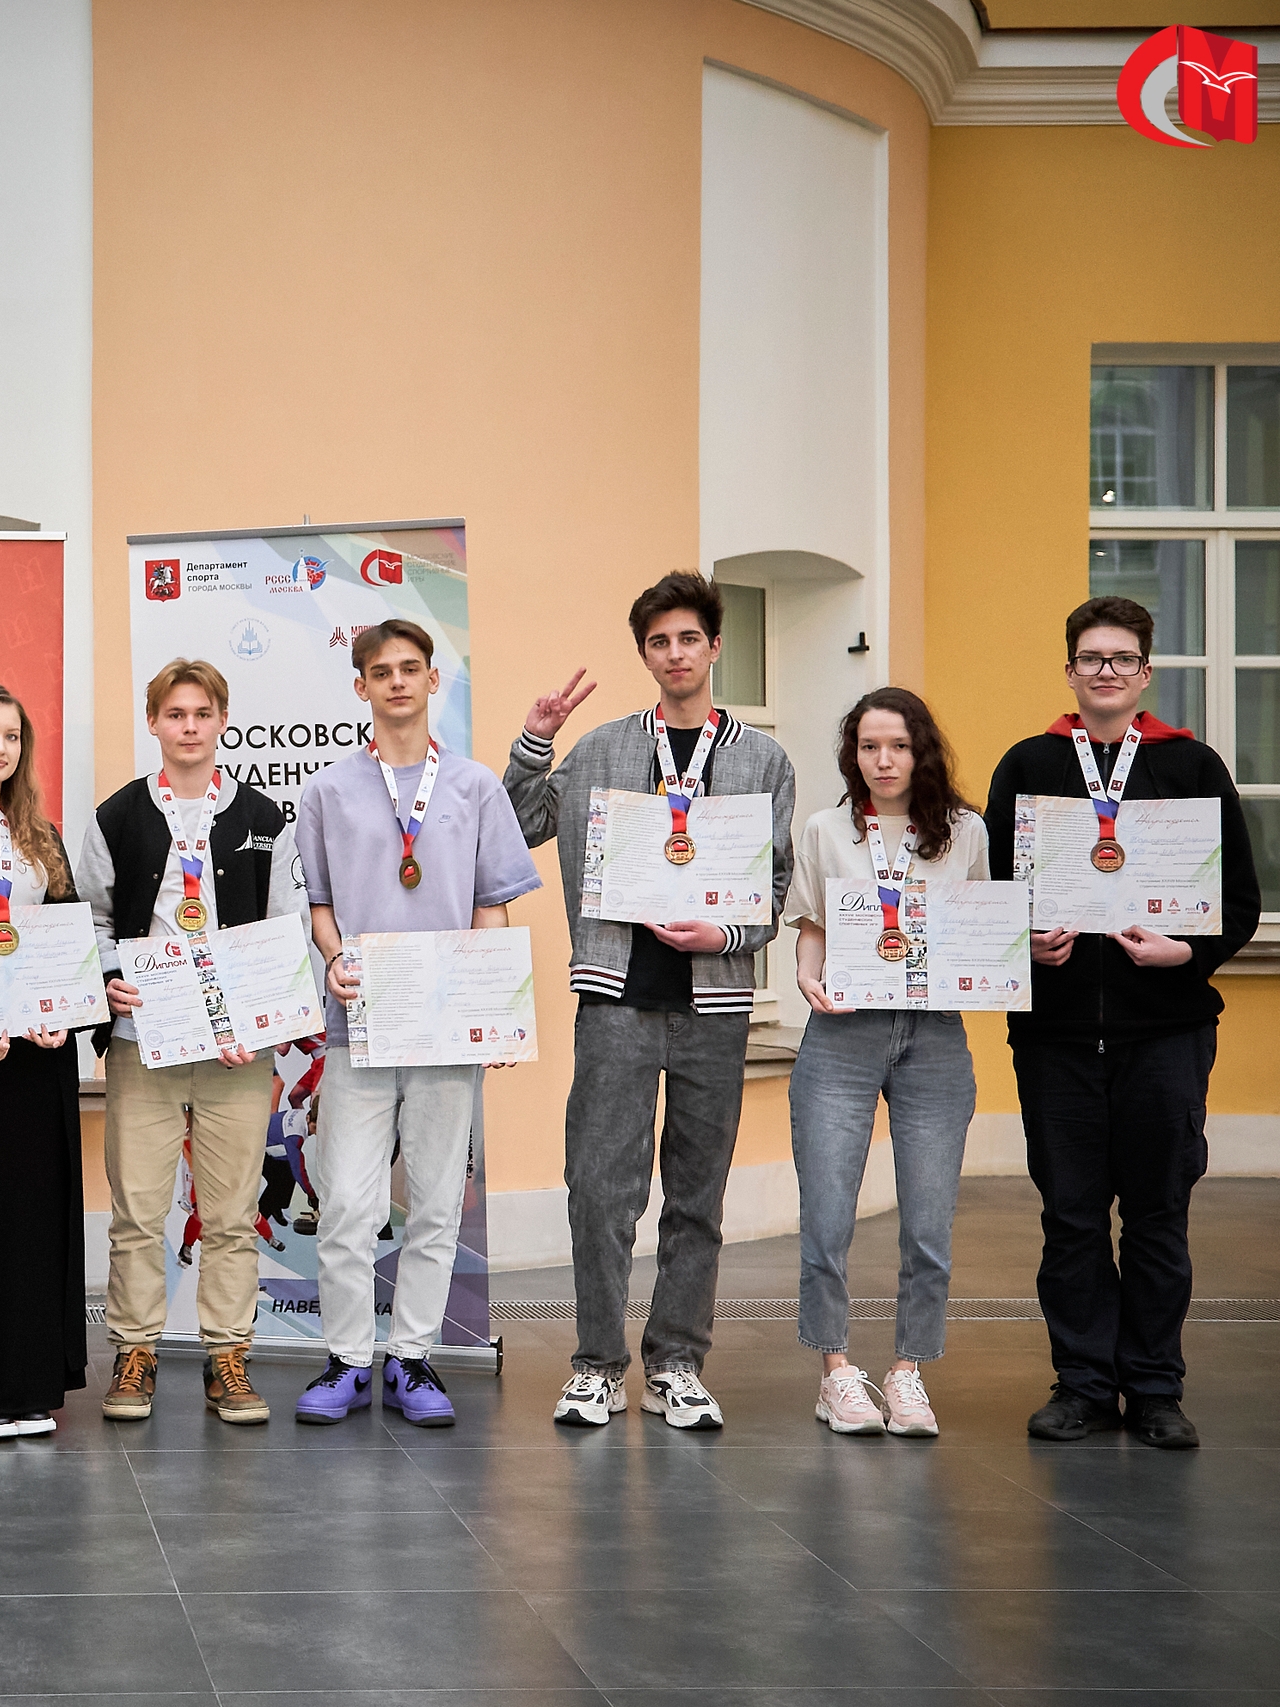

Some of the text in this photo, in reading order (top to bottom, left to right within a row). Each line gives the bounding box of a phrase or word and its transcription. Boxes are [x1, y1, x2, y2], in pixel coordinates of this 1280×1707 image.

[186, 561, 248, 572] Департамент
[187, 573, 219, 582] спорта
[265, 575, 291, 585] РССС
[219, 583, 253, 591] МОСКВЫ
[269, 585, 304, 593] МОСКВА
[272, 1299, 321, 1317] НАВЕ
